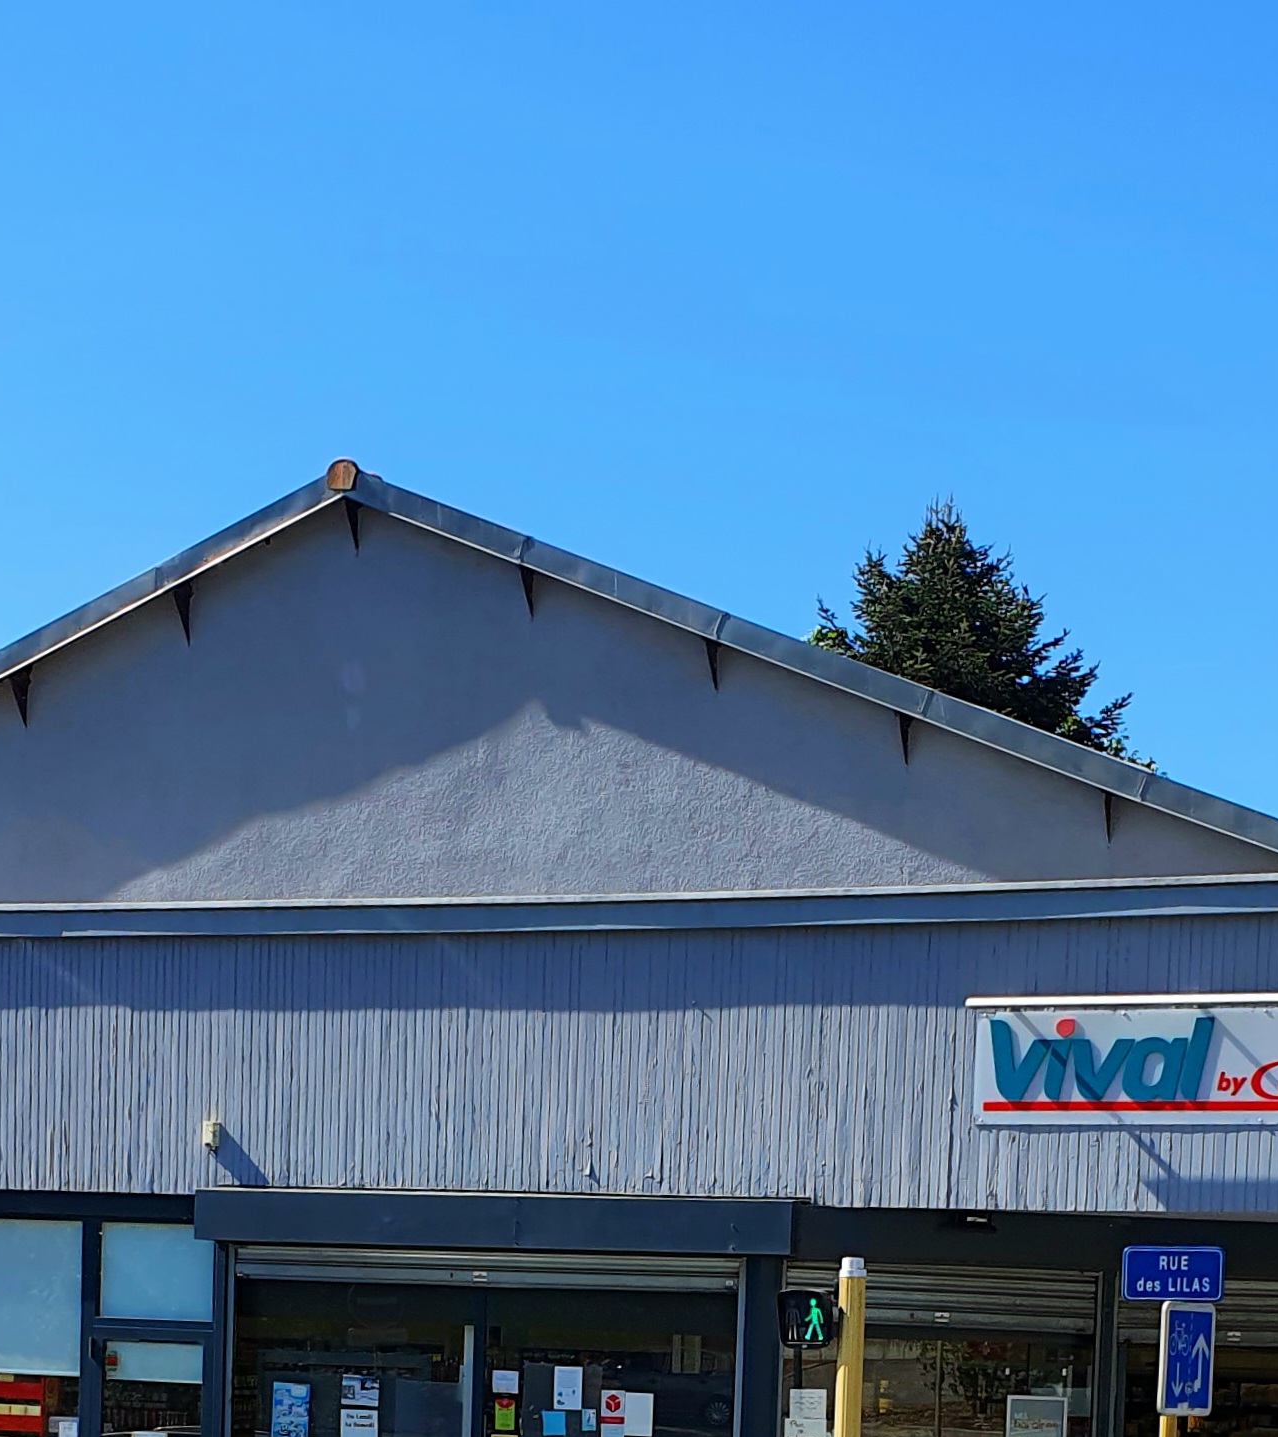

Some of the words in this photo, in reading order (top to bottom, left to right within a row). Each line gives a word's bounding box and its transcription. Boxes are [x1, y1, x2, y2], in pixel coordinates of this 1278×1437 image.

[990, 1017, 1215, 1101] Vival
[1217, 1072, 1247, 1096] by
[1159, 1255, 1189, 1271] RUE
[1136, 1277, 1161, 1292] des
[1168, 1277, 1211, 1292] LILAS
